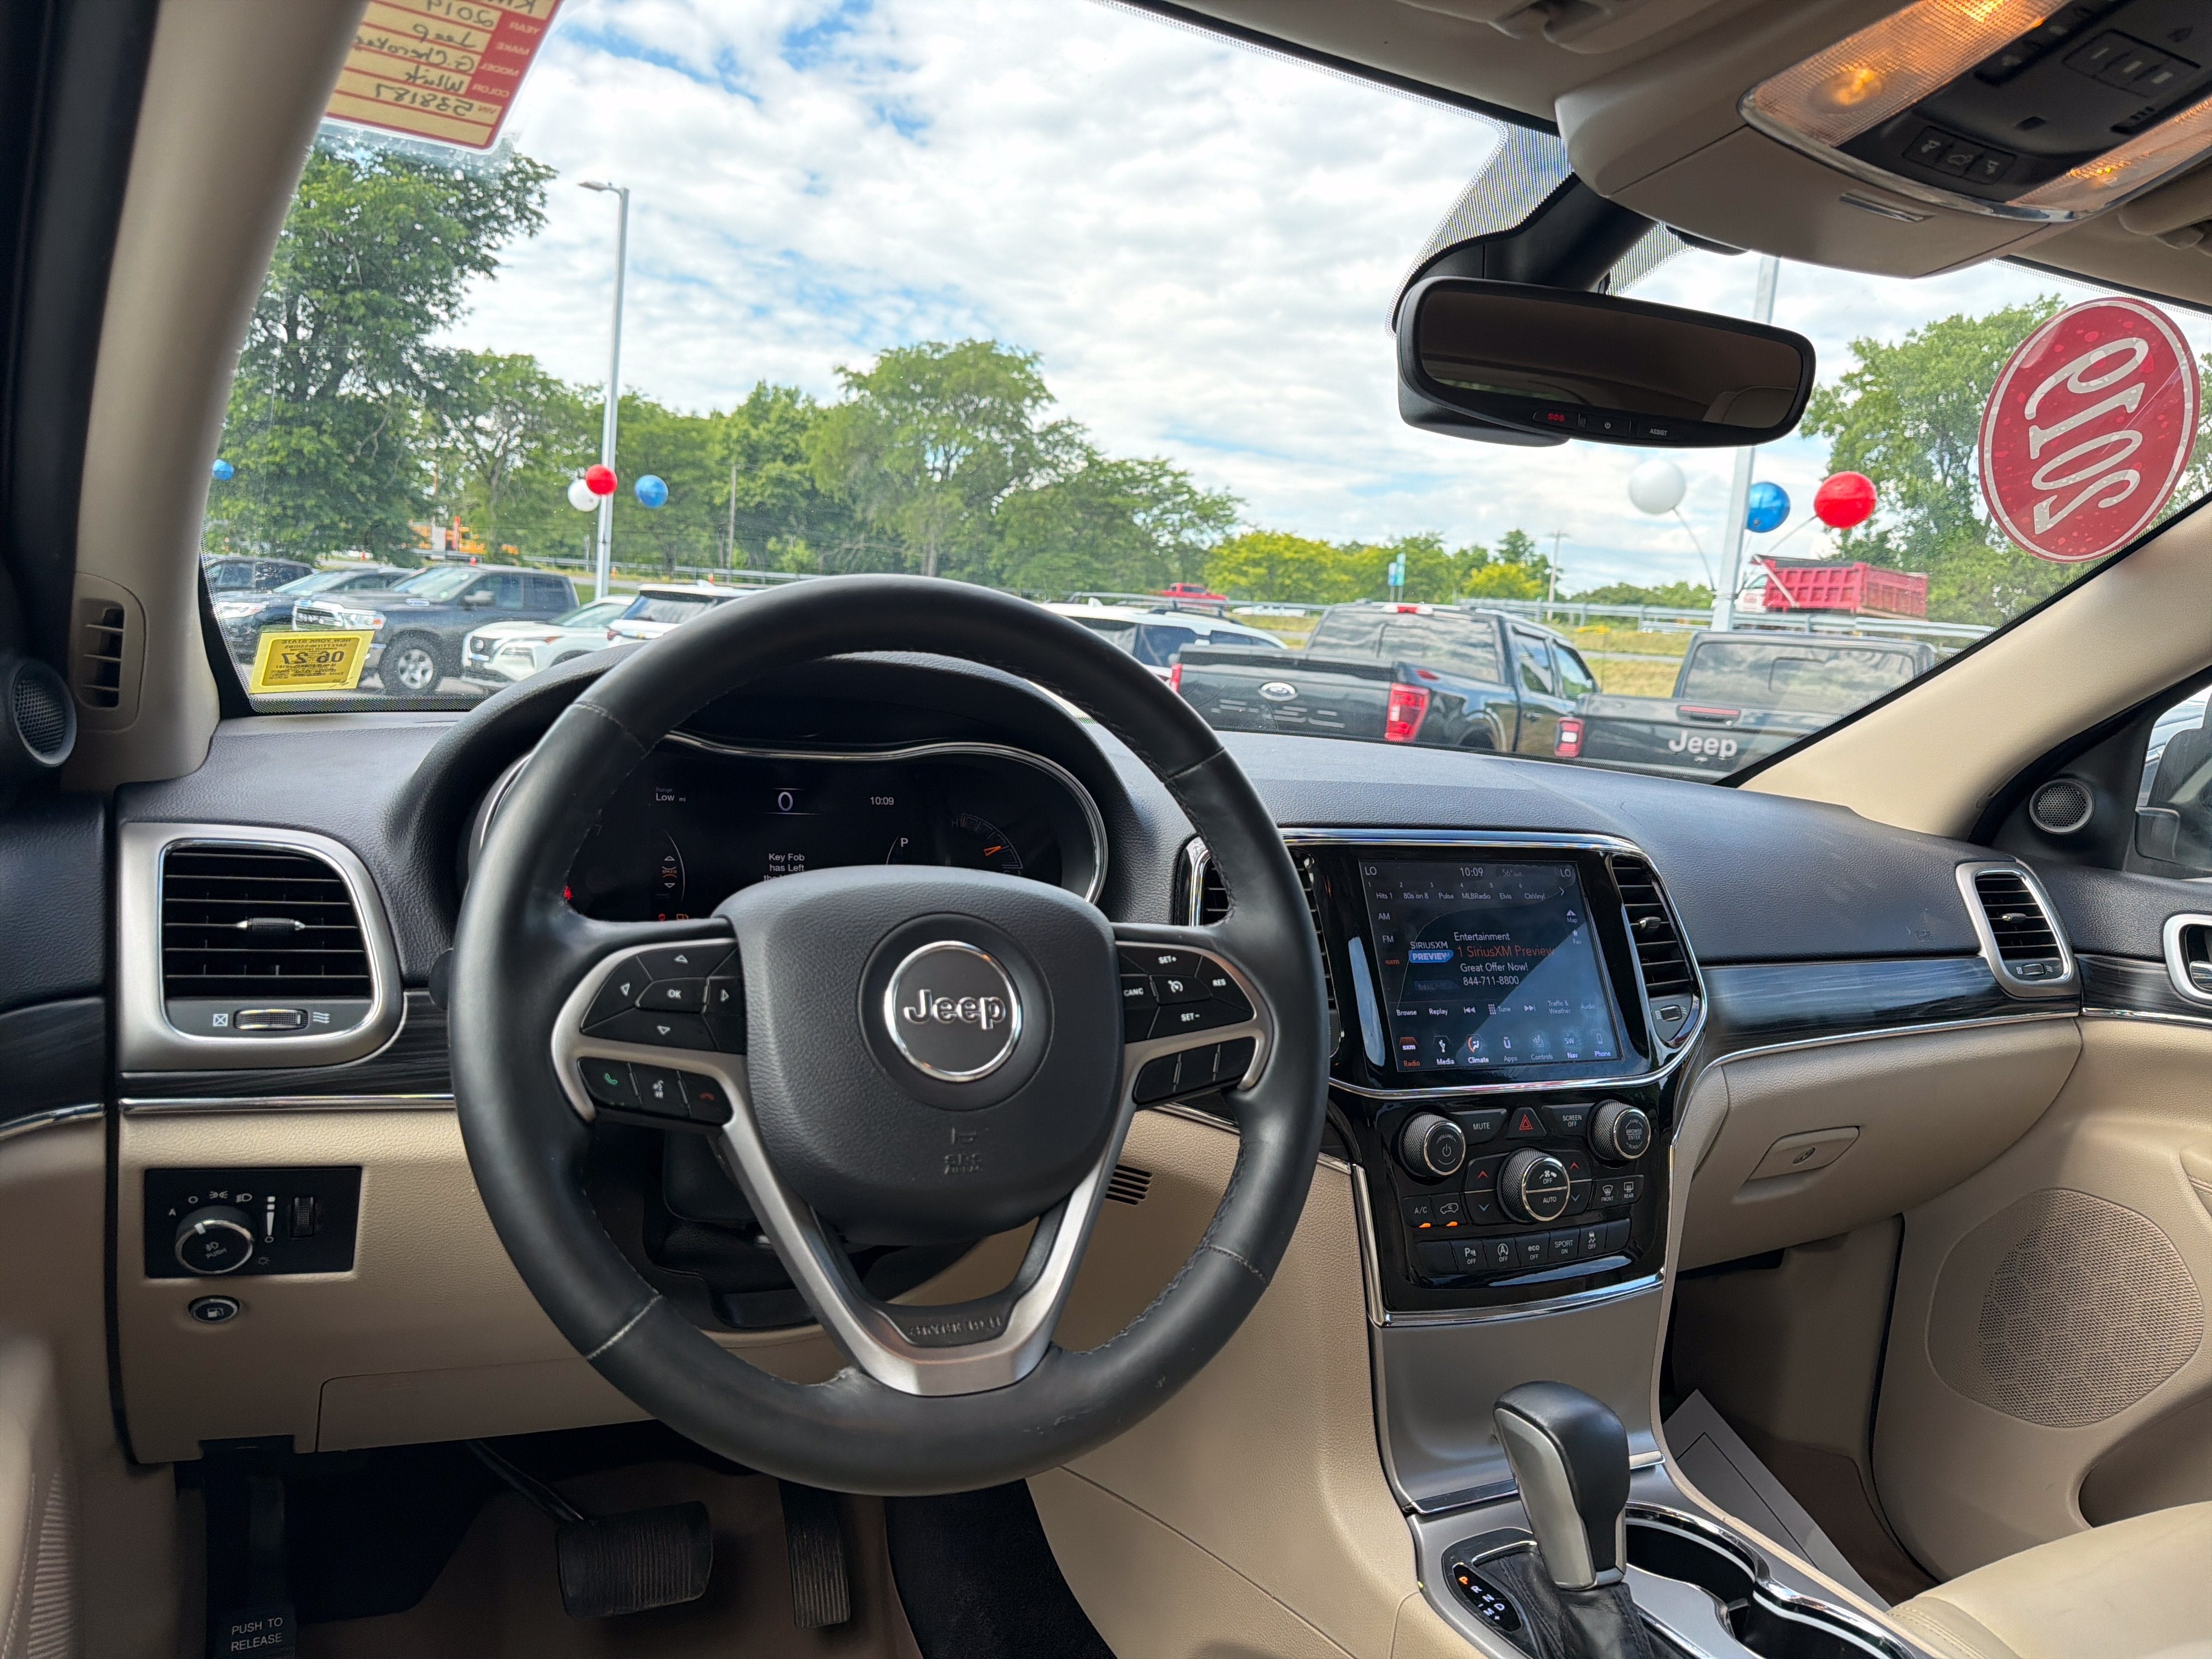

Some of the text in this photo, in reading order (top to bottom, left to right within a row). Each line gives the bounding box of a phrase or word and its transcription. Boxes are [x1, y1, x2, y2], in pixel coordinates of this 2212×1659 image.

[1548, 413, 1565, 422] SOS
[1650, 428, 1668, 436] ASSIST
[1668, 730, 1737, 760] Jeep
[656, 793, 675, 801] Low
[870, 797, 894, 805] 10:09
[900, 838, 909, 847] P
[769, 853, 805, 862] Key Fob
[1364, 866, 1377, 876] LO
[1459, 867, 1484, 877] 10:09
[1560, 868, 1571, 877] LO
[1454, 932, 1510, 941] Entertainment
[1410, 941, 1448, 950] SIRIUSXM
[1457, 945, 1554, 957] 1 SiriusXM Preview
[1460, 962, 1528, 973] Great Offer Now!
[1212, 978, 1226, 986] RES
[1463, 975, 1519, 986] 844-711-8800
[667, 989, 681, 999] OK
[1124, 988, 1144, 996] CANC
[903, 989, 1006, 1030] Jeep
[1429, 1008, 1448, 1016] Replay
[1414, 1206, 1427, 1214] A/C
[1554, 1239, 1573, 1248] SPORT
[1459, 1576, 1468, 1585] P
[1482, 1594, 1494, 1602] N
[232, 1617, 283, 1635] PUSH TO
[231, 1632, 282, 1652] RELEASE
